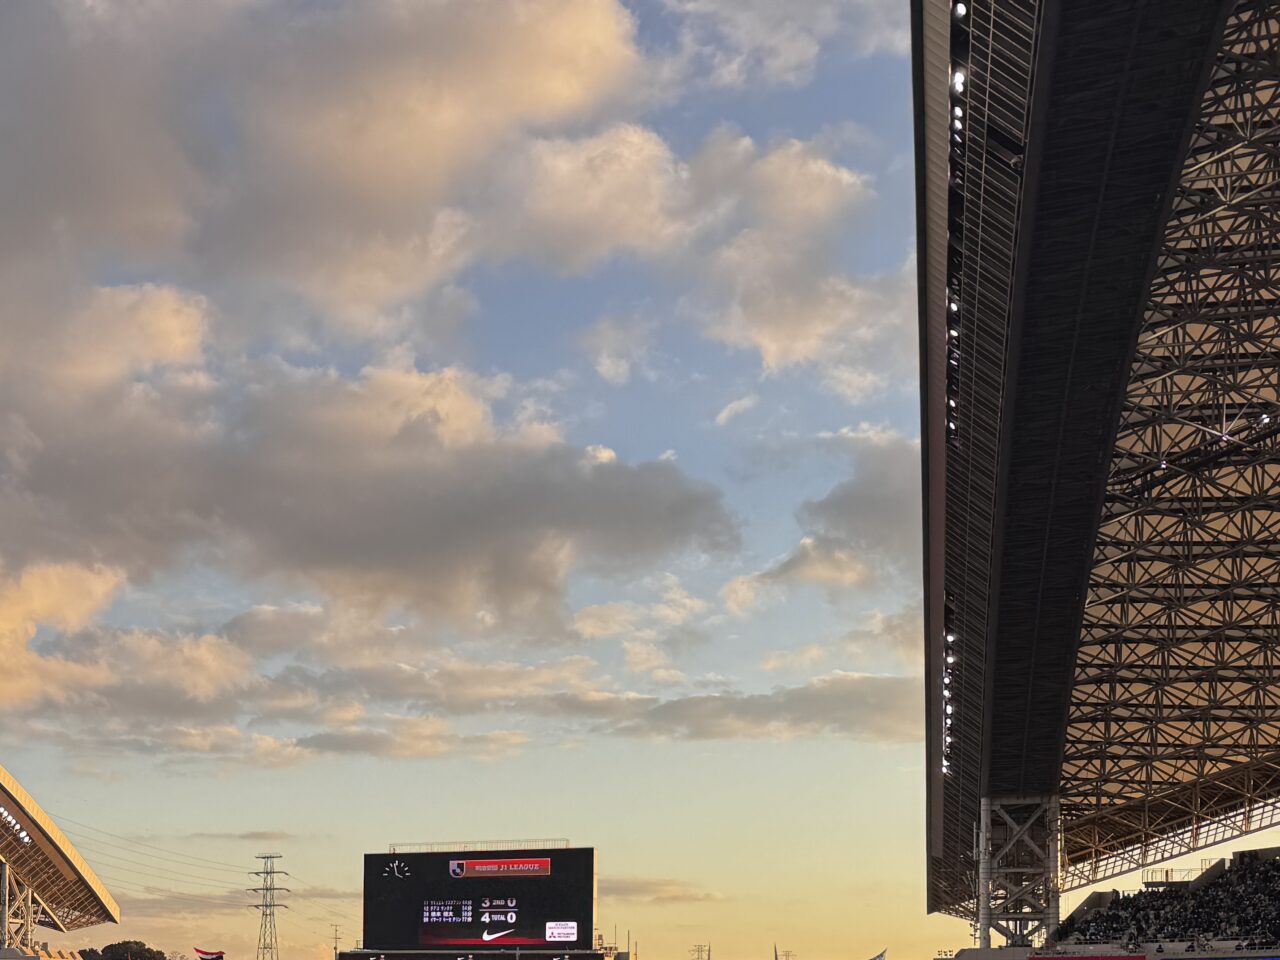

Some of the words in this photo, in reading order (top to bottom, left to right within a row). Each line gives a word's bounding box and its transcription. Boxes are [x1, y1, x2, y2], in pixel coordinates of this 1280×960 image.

[481, 898, 490, 908] 3
[480, 912, 490, 923] 4
[507, 912, 517, 923] 0
